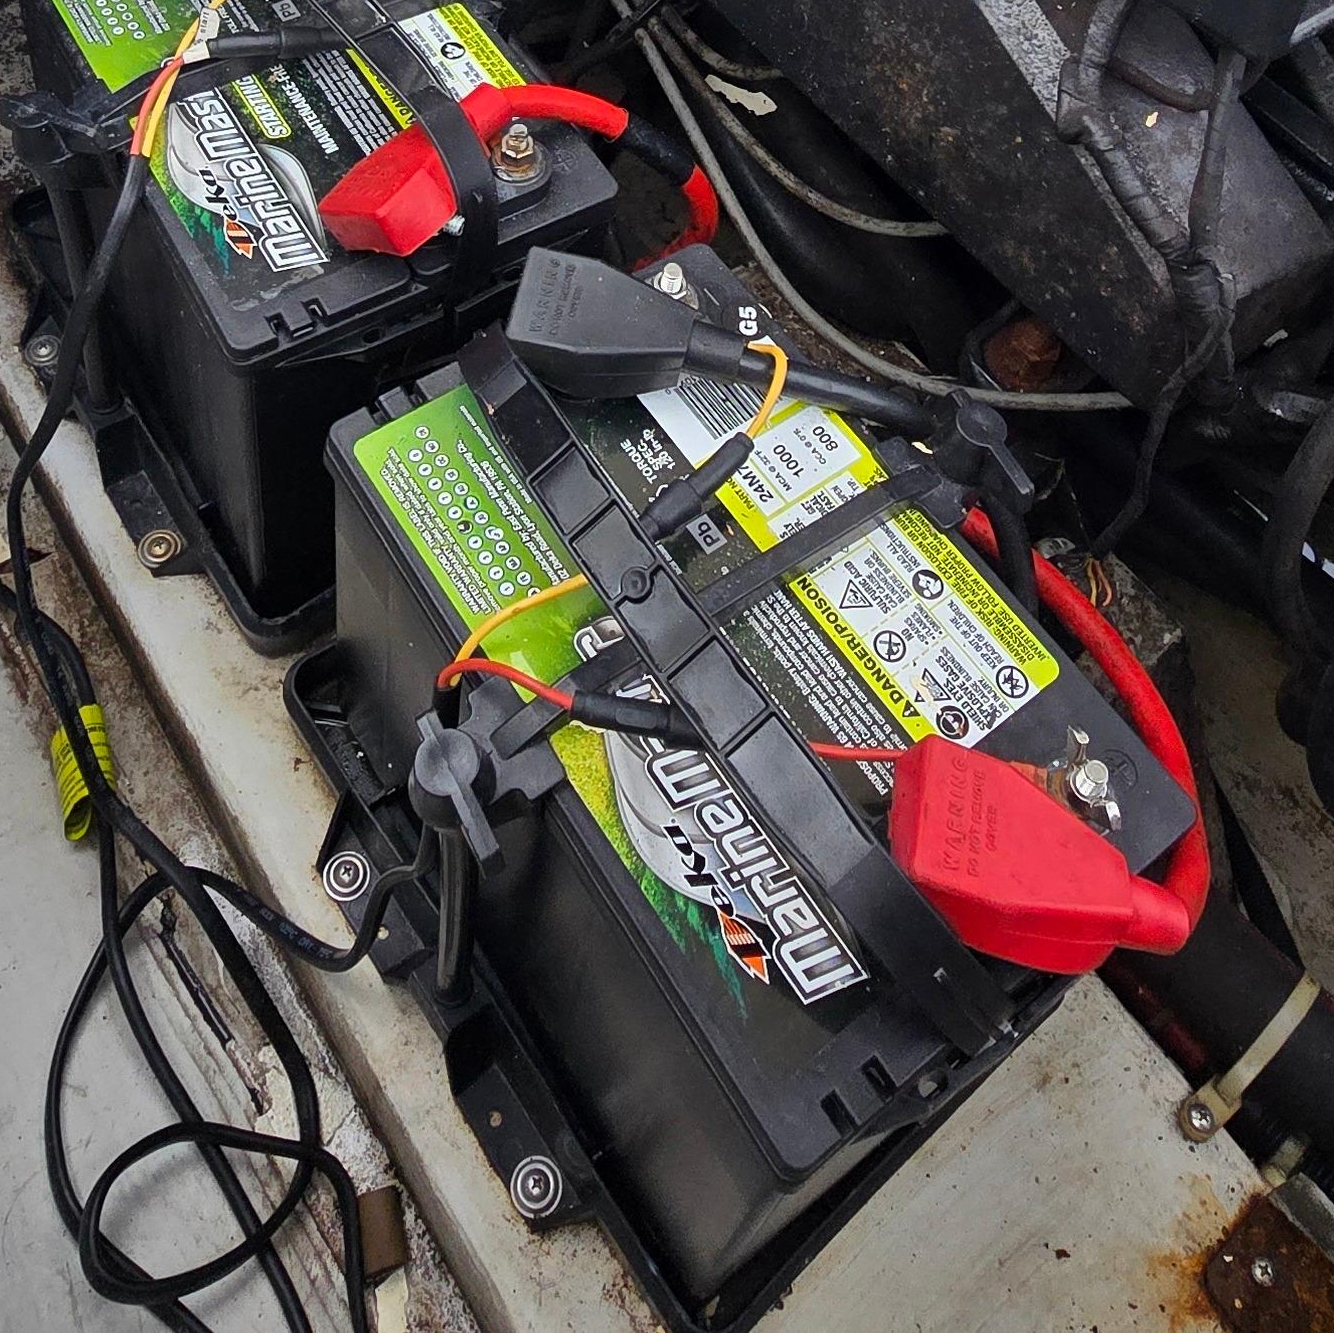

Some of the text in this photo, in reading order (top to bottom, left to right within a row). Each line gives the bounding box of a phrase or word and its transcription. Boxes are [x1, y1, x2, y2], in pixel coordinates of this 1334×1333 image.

[224, 17, 239, 34] TOLL
[278, 1, 295, 18] Pb
[234, 73, 288, 142] STARTING
[270, 62, 339, 154] MAINTENANCE-FRE
[191, 164, 259, 259] Deka
[528, 257, 560, 333] WARNING
[737, 304, 757, 336] G5
[811, 423, 839, 453] 800
[619, 438, 658, 484] TORQUE
[634, 438, 664, 471] SPEC.
[657, 449, 677, 470] 120
[771, 441, 806, 478] 1000
[809, 447, 827, 465] CCA
[462, 451, 522, 531] East Penn Manufacturing
[774, 470, 792, 491] MCA
[735, 488, 755, 510] PART
[800, 499, 816, 515] GET
[816, 490, 835, 510] FAST.
[493, 479, 563, 571] Deka PA
[693, 519, 720, 548] Pb
[907, 529, 920, 542] OR
[401, 500, 480, 614] WARRANTY VOID THIS LABEL IS
[885, 541, 914, 573] READ ALL
[916, 539, 954, 580] EXPLOSION
[440, 542, 491, 614] LIMITED WARRANTY
[843, 560, 891, 615] SULFURIC ACID
[863, 556, 906, 604] BLINDNESS OR
[864, 572, 898, 609] CAN CAUSE
[887, 573, 912, 599] SEVERE
[927, 539, 1035, 661] DISASSEMBLE OR NOT
[946, 548, 1046, 661] INVERTED FOLLOW PROPER
[965, 596, 979, 609] OF
[974, 607, 994, 628] RISK
[797, 576, 904, 705] DANGER/POISON
[900, 627, 914, 641] NO
[949, 615, 997, 669] KEEP OUT OF THE
[974, 631, 985, 642] OF
[798, 650, 820, 675] cancer
[982, 640, 1004, 664] REACH
[771, 601, 885, 742] also contain other chemicals known to the
[785, 666, 811, 695] Battery
[787, 607, 892, 734] to WASH HANDS AFTER
[939, 645, 1002, 718] CAN CAUSE BLINDNESS
[812, 685, 827, 701] and
[832, 695, 843, 706] to
[935, 655, 994, 724] EXPLOSIVE GASES
[823, 699, 840, 718] lead
[839, 703, 871, 739] California
[960, 700, 987, 731] SHIELD
[999, 703, 1009, 712] OR
[836, 716, 861, 744] contain
[942, 755, 967, 872] WARNING
[966, 824, 981, 854] NOT
[653, 818, 773, 974] Deka
